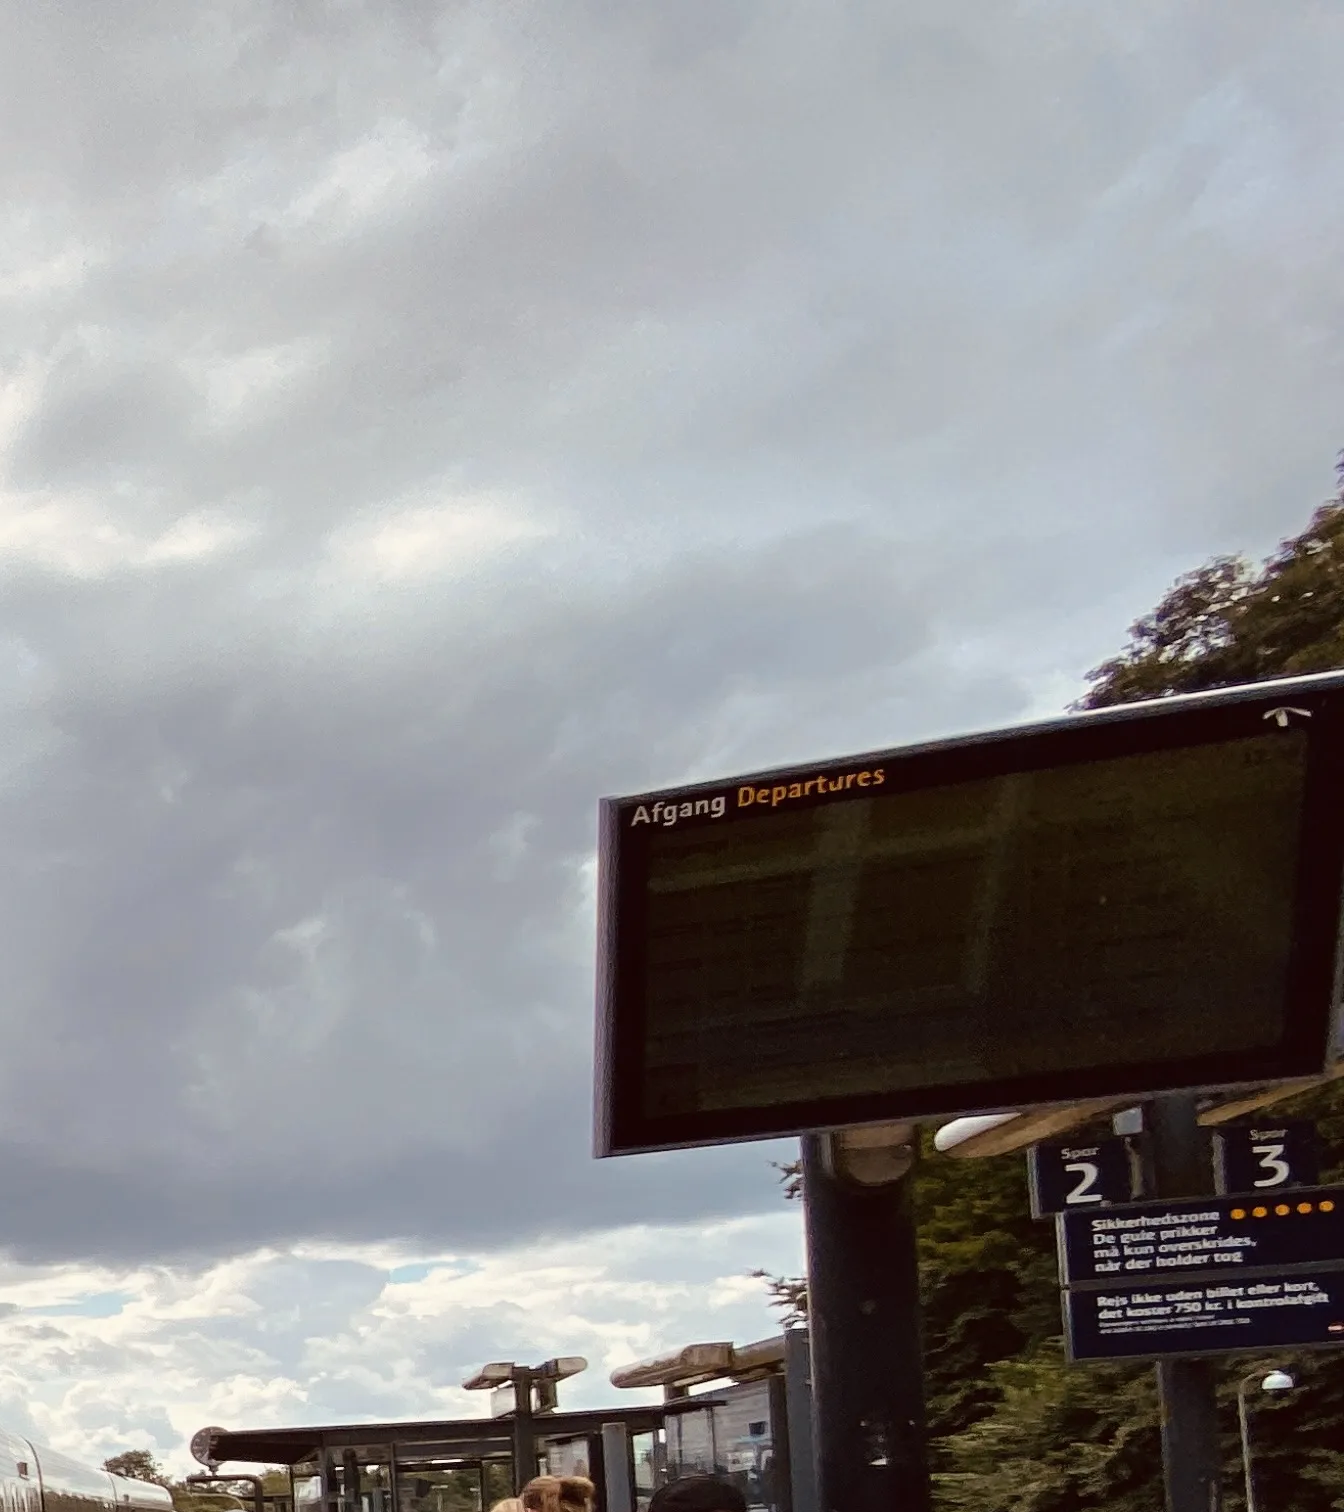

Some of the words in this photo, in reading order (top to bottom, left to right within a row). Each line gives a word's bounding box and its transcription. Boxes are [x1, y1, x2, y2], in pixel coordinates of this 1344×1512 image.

[630, 796, 726, 827] Afgang
[737, 768, 885, 807] Departures
[1252, 1144, 1290, 1187] 3
[1065, 1162, 1102, 1204] 2
[1091, 1212, 1220, 1231] Sikkerhedszone
[1093, 1234, 1116, 1244] De
[1160, 1226, 1218, 1241] prikker
[1093, 1245, 1119, 1258] må
[1124, 1245, 1155, 1256] kun
[1125, 1259, 1152, 1270] der
[1156, 1254, 1210, 1267] holder
[1096, 1295, 1128, 1308] Rejs
[1131, 1293, 1162, 1304] ikke
[1165, 1290, 1203, 1302] uden
[1206, 1287, 1244, 1298] billet
[1247, 1284, 1281, 1295] eller
[1098, 1308, 1123, 1319] det
[1126, 1305, 1172, 1317] koster
[1174, 1302, 1202, 1313] 750
